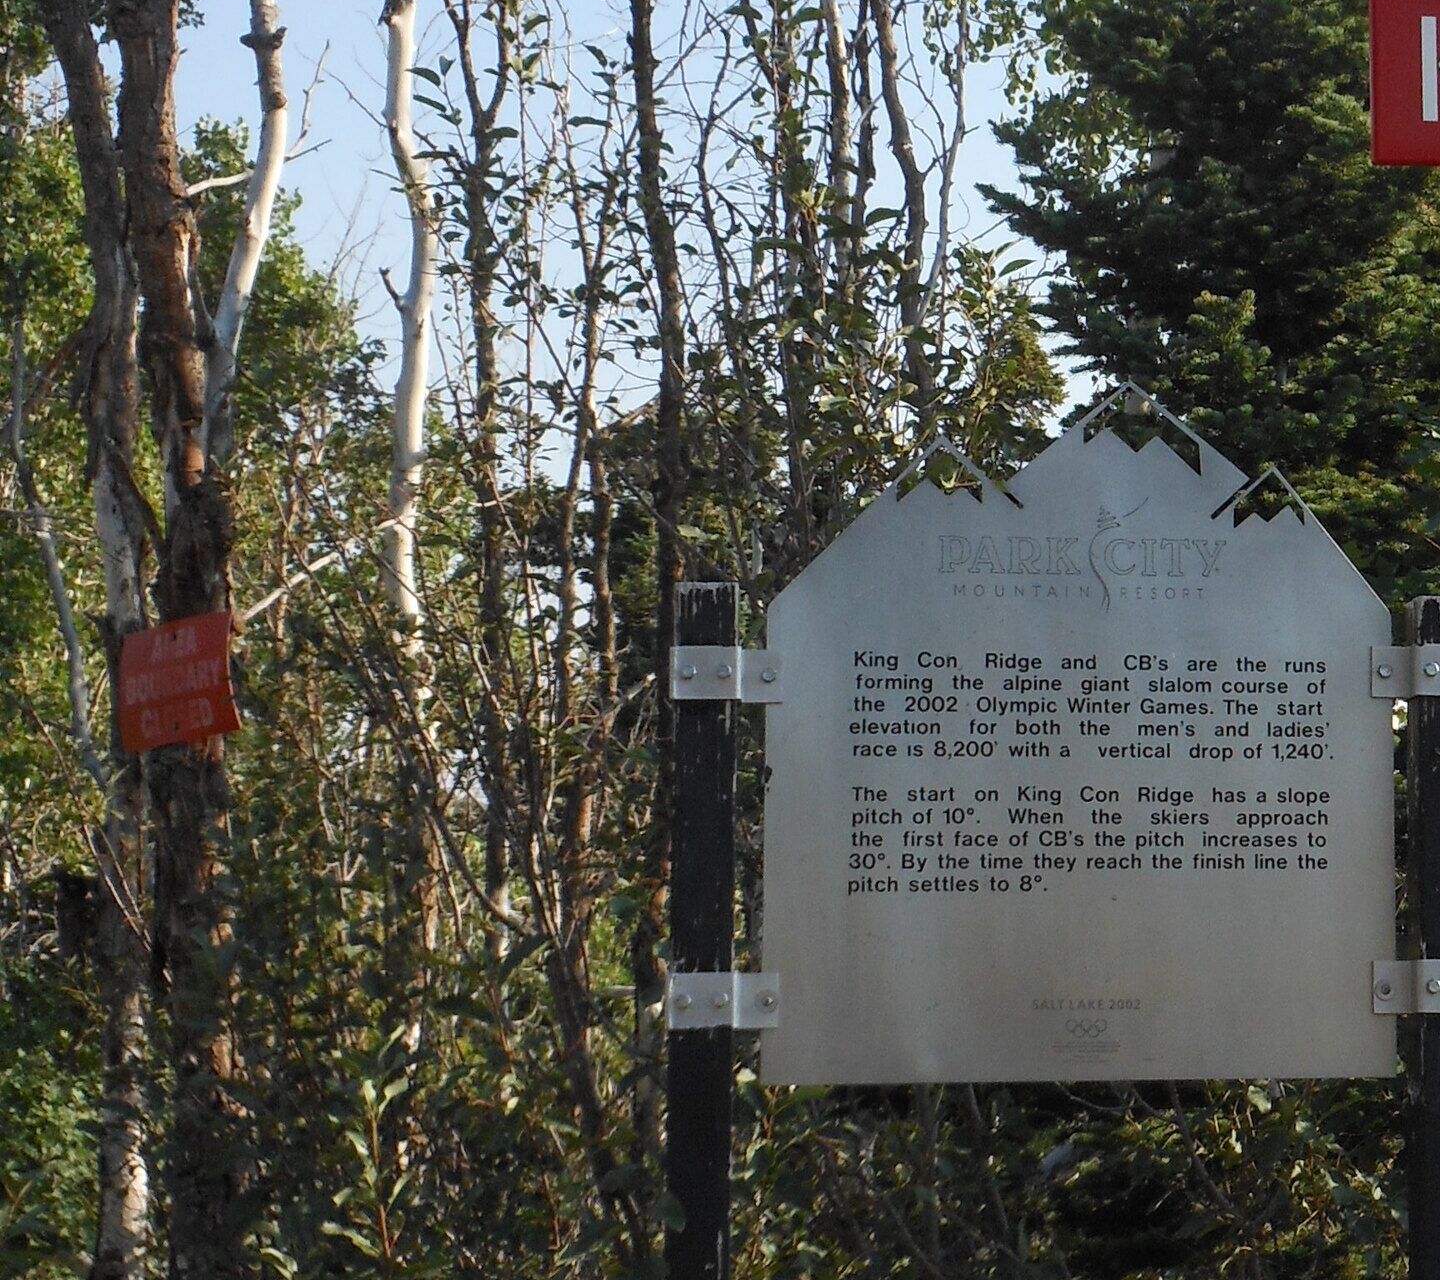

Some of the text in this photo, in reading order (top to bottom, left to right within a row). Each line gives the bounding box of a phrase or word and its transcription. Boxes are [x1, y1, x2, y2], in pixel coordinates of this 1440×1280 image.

[937, 534, 1227, 577] PARK CITY
[953, 584, 1205, 600] MOUNTAIN RESORT
[853, 650, 1327, 674] King Con Ridge and CB's are the runs
[855, 673, 1327, 696] forming the alpine giant slalom course of
[853, 695, 1324, 717] the 2002 Olympic Winter Games. The start
[848, 717, 1330, 739] elevation for both the men's and ladies'
[852, 744, 898, 758] race
[906, 742, 924, 758] is
[1007, 740, 1050, 759] with
[1058, 744, 1071, 758] a
[1097, 741, 1171, 759] vertical
[1188, 742, 1234, 763] drop
[1242, 742, 1263, 760] of
[851, 784, 1331, 807] The start on King Con Ridge has a slope
[851, 807, 903, 829] pitch
[911, 807, 934, 825] of
[1007, 807, 1064, 826] When
[1090, 807, 1123, 826] the
[1149, 808, 1210, 826] skiers
[1235, 809, 1329, 829] approach
[850, 829, 1327, 851] the first face of CB's the pitch increases to
[900, 852, 928, 874] By
[937, 852, 970, 870] the
[979, 852, 1024, 870] time
[1032, 852, 1077, 873] they
[1086, 852, 1142, 870] reach
[1151, 852, 1183, 870] the
[1192, 852, 1246, 870] finish
[1254, 853, 1289, 870] line
[1296, 853, 1329, 870] the
[847, 875, 899, 897] pitch
[908, 875, 980, 893] settles
[988, 875, 1010, 893] to
[1032, 999, 1142, 1010] SALT LAKE 2002
